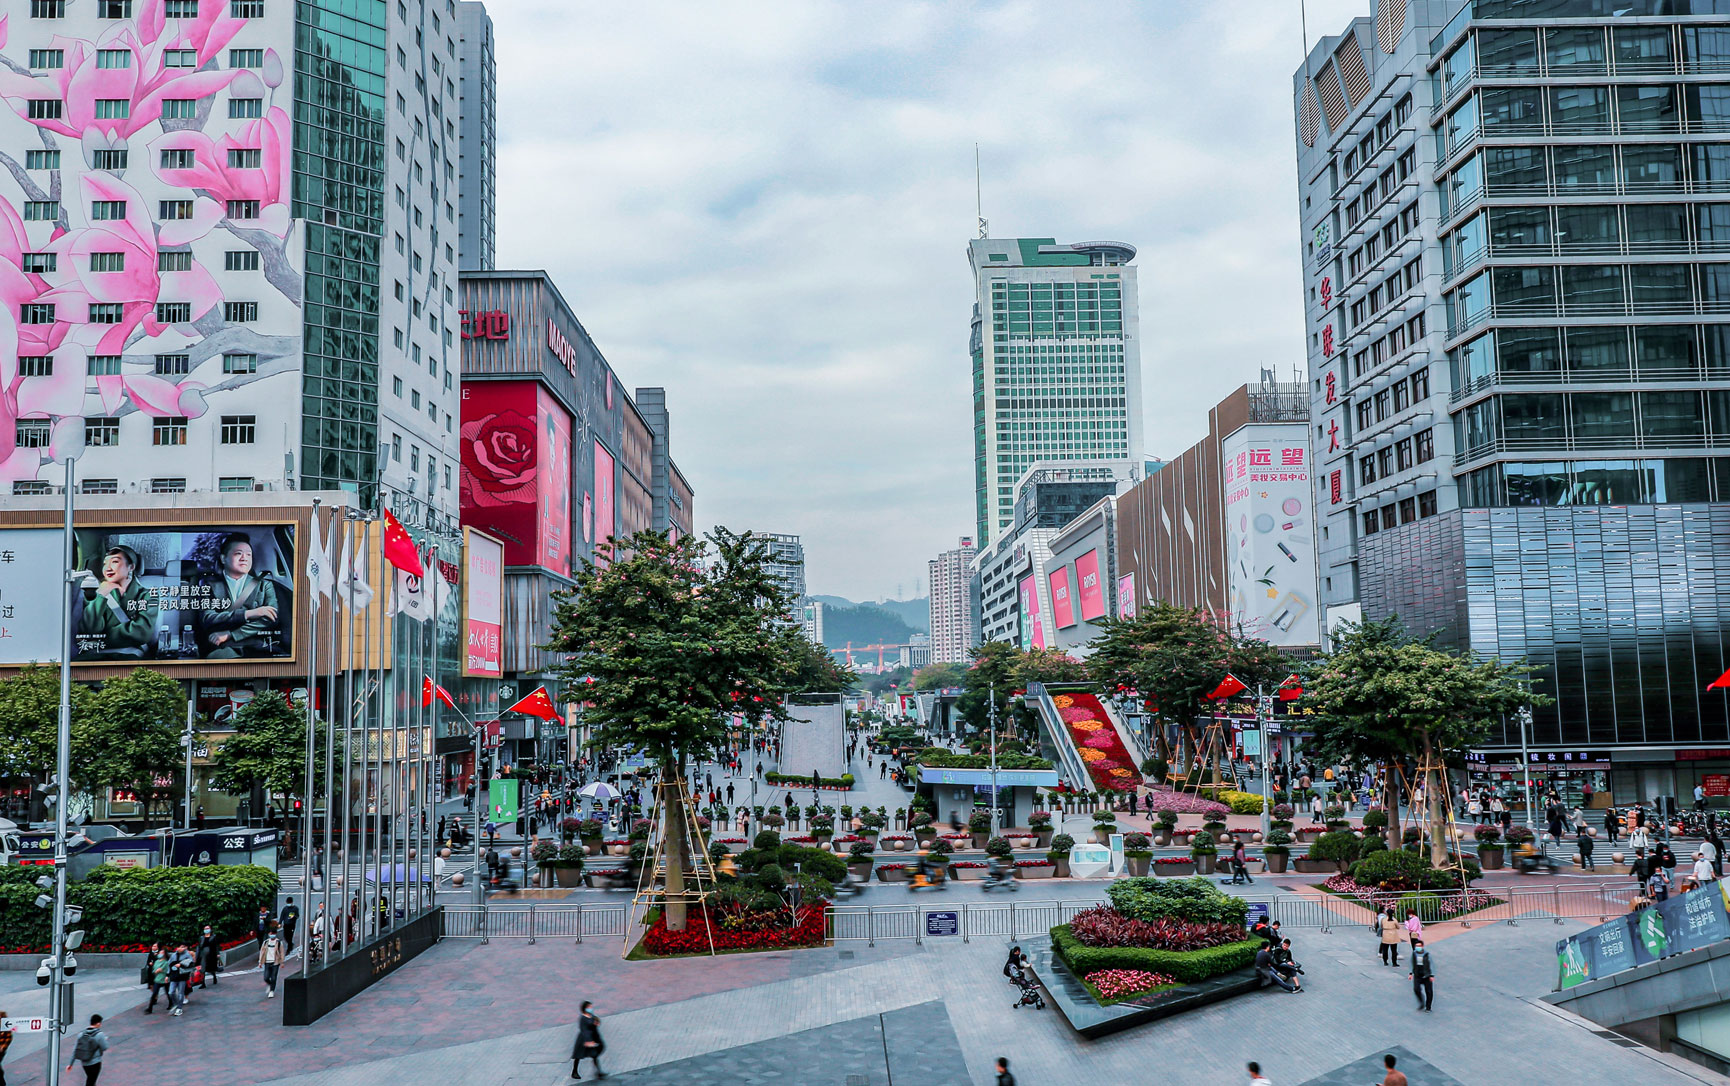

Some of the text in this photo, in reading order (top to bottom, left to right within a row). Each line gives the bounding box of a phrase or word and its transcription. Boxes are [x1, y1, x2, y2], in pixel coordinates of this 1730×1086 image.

[547, 317, 577, 378] MAOYE
[1320, 276, 1342, 504] 华联发大厦
[1249, 448, 1304, 466] 远望
[1225, 451, 1247, 484] 远望
[1250, 473, 1308, 482] 美妆交易中心
[148, 585, 211, 598] 在安静里放空
[126, 599, 232, 611] 欣赏一段风景也很美妙
[20, 841, 39, 849] 公安
[223, 836, 246, 849] 公安
[1689, 911, 1717, 930] 法治护航
[1598, 926, 1622, 945] 文明出行
[1601, 941, 1625, 958] 平安回家
